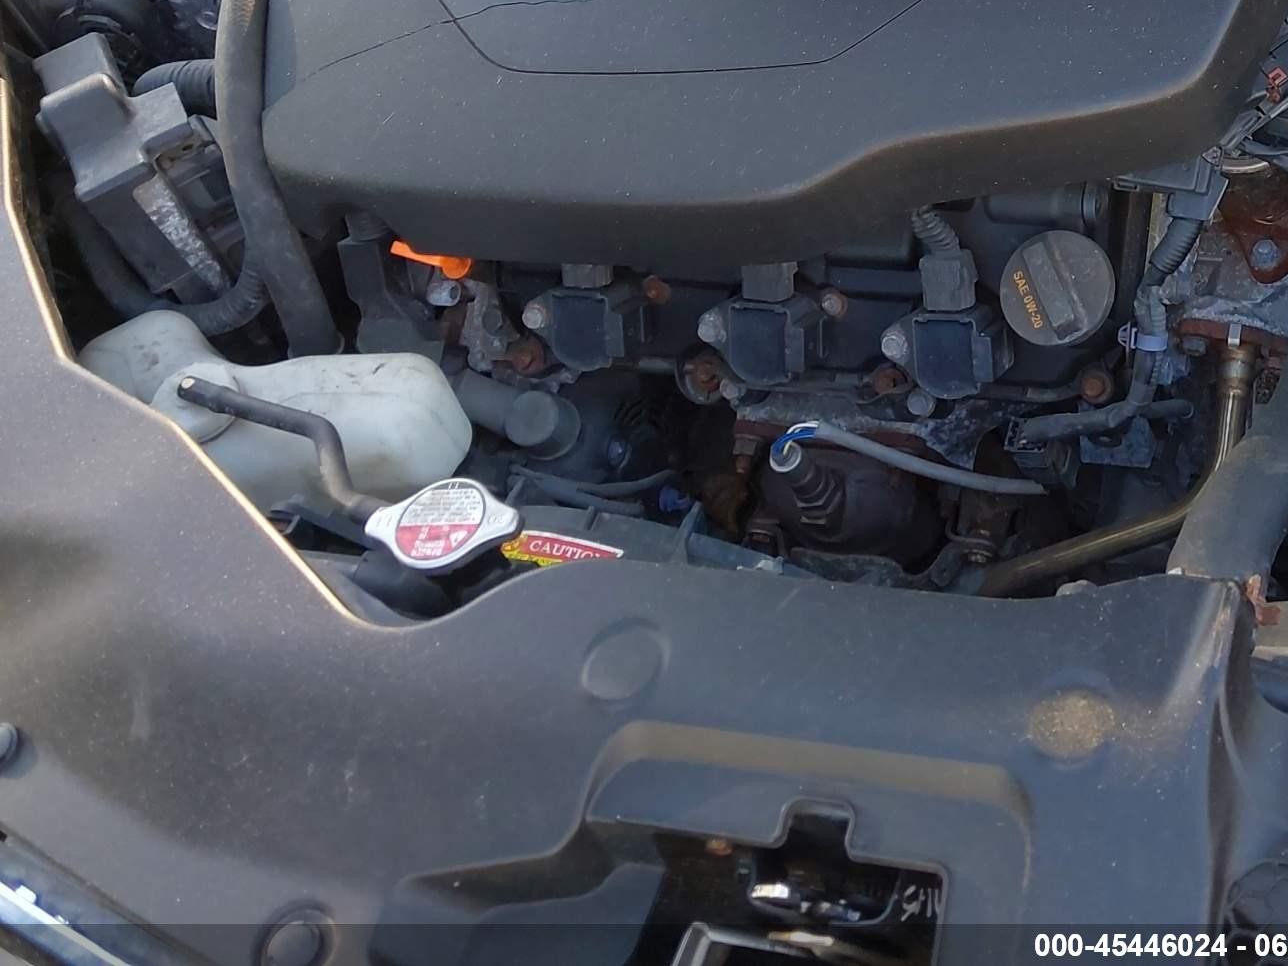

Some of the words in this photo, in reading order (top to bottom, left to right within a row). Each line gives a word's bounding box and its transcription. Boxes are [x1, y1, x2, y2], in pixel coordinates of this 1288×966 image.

[1013, 270, 1030, 297] SAE
[1023, 294, 1044, 329] 0W-20
[529, 539, 600, 560] CAUTIO
